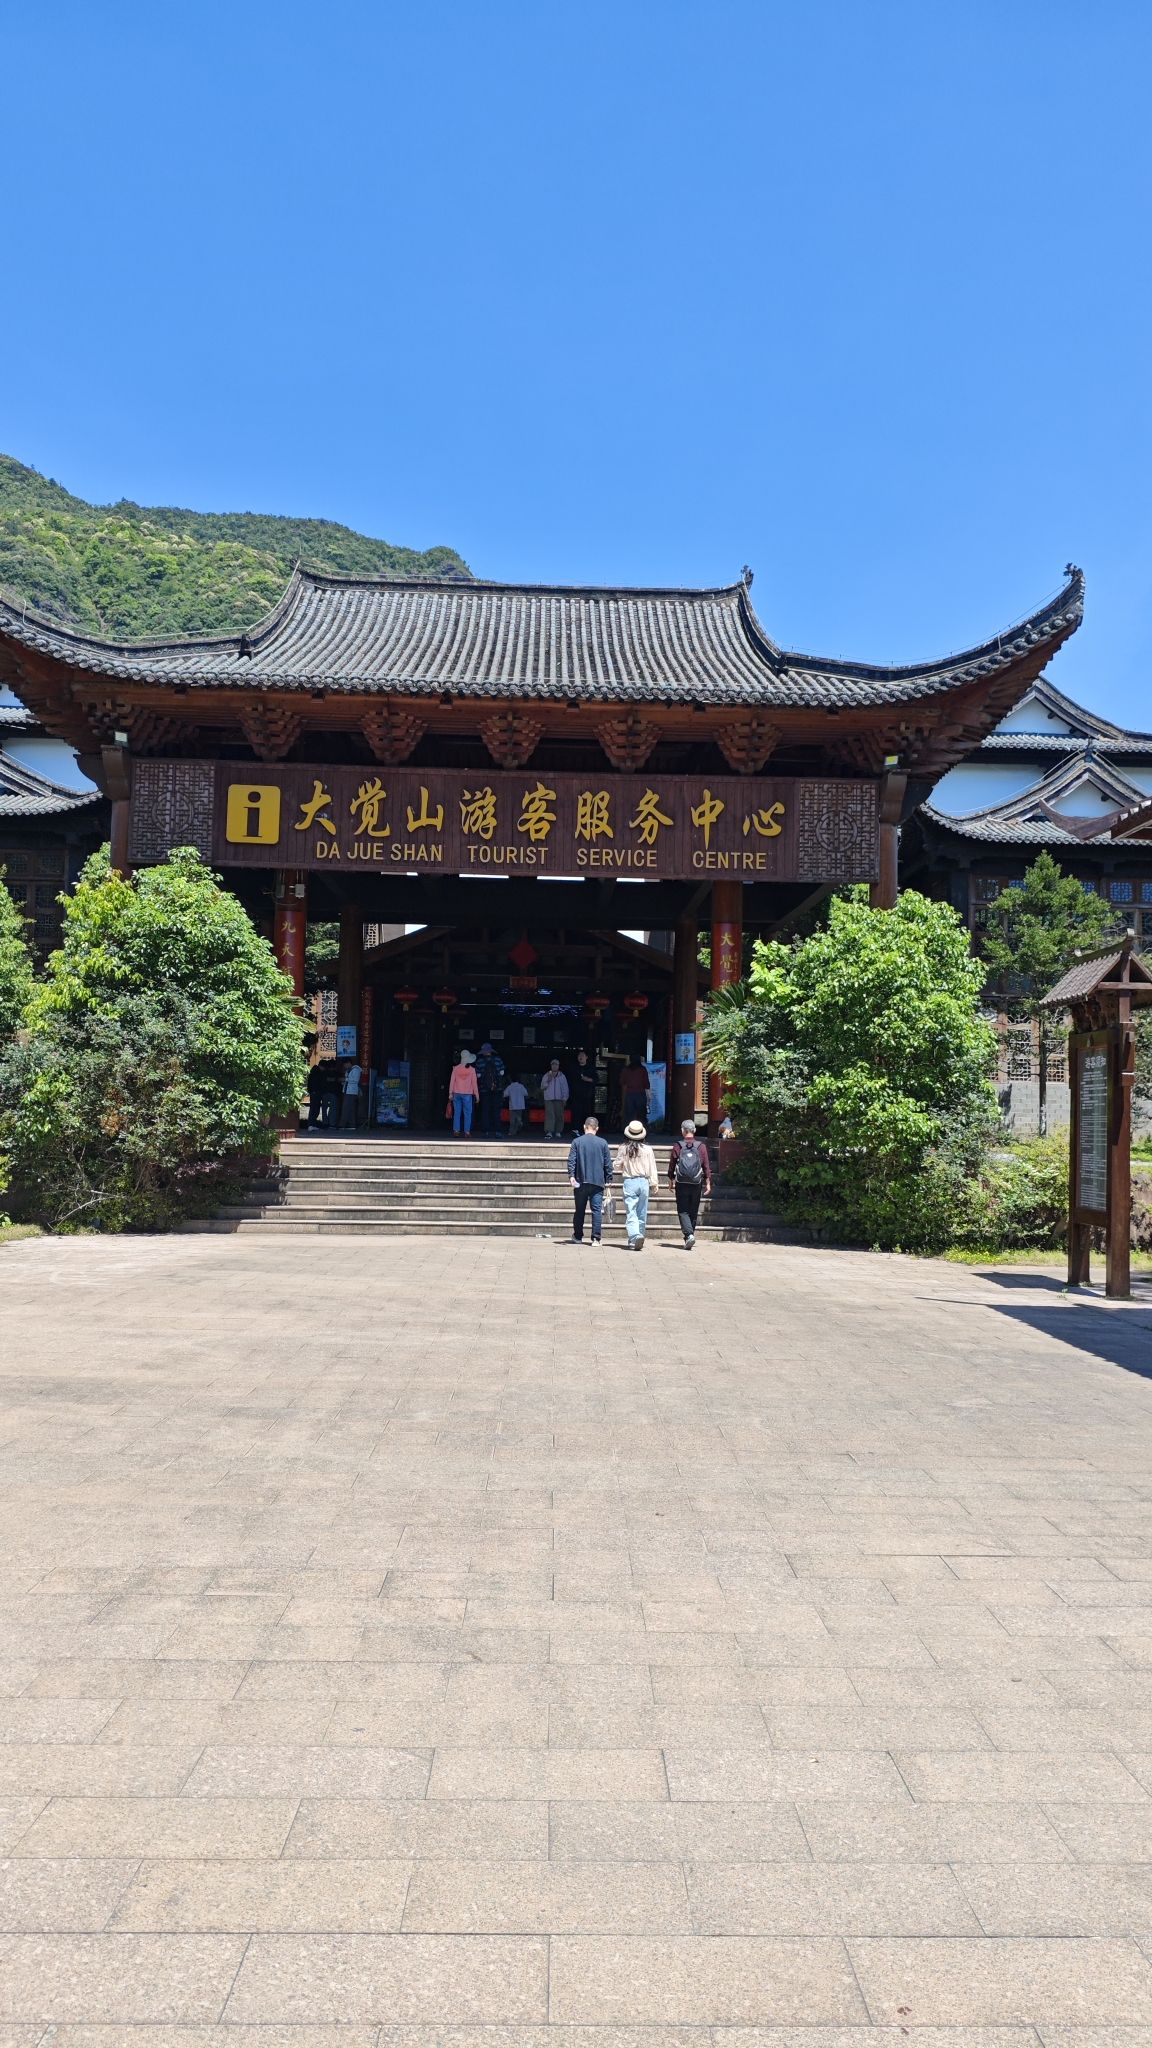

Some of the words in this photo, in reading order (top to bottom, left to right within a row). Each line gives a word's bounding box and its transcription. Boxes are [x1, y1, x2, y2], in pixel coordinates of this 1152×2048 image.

[294, 777, 786, 850] 大觉山游客服务中心
[316, 841, 341, 859] DA
[347, 842, 384, 861] JUE
[390, 843, 443, 863] SHAN
[467, 845, 549, 865] TOURIST
[576, 847, 658, 867] SERVICE
[692, 851, 767, 870] CENTRE
